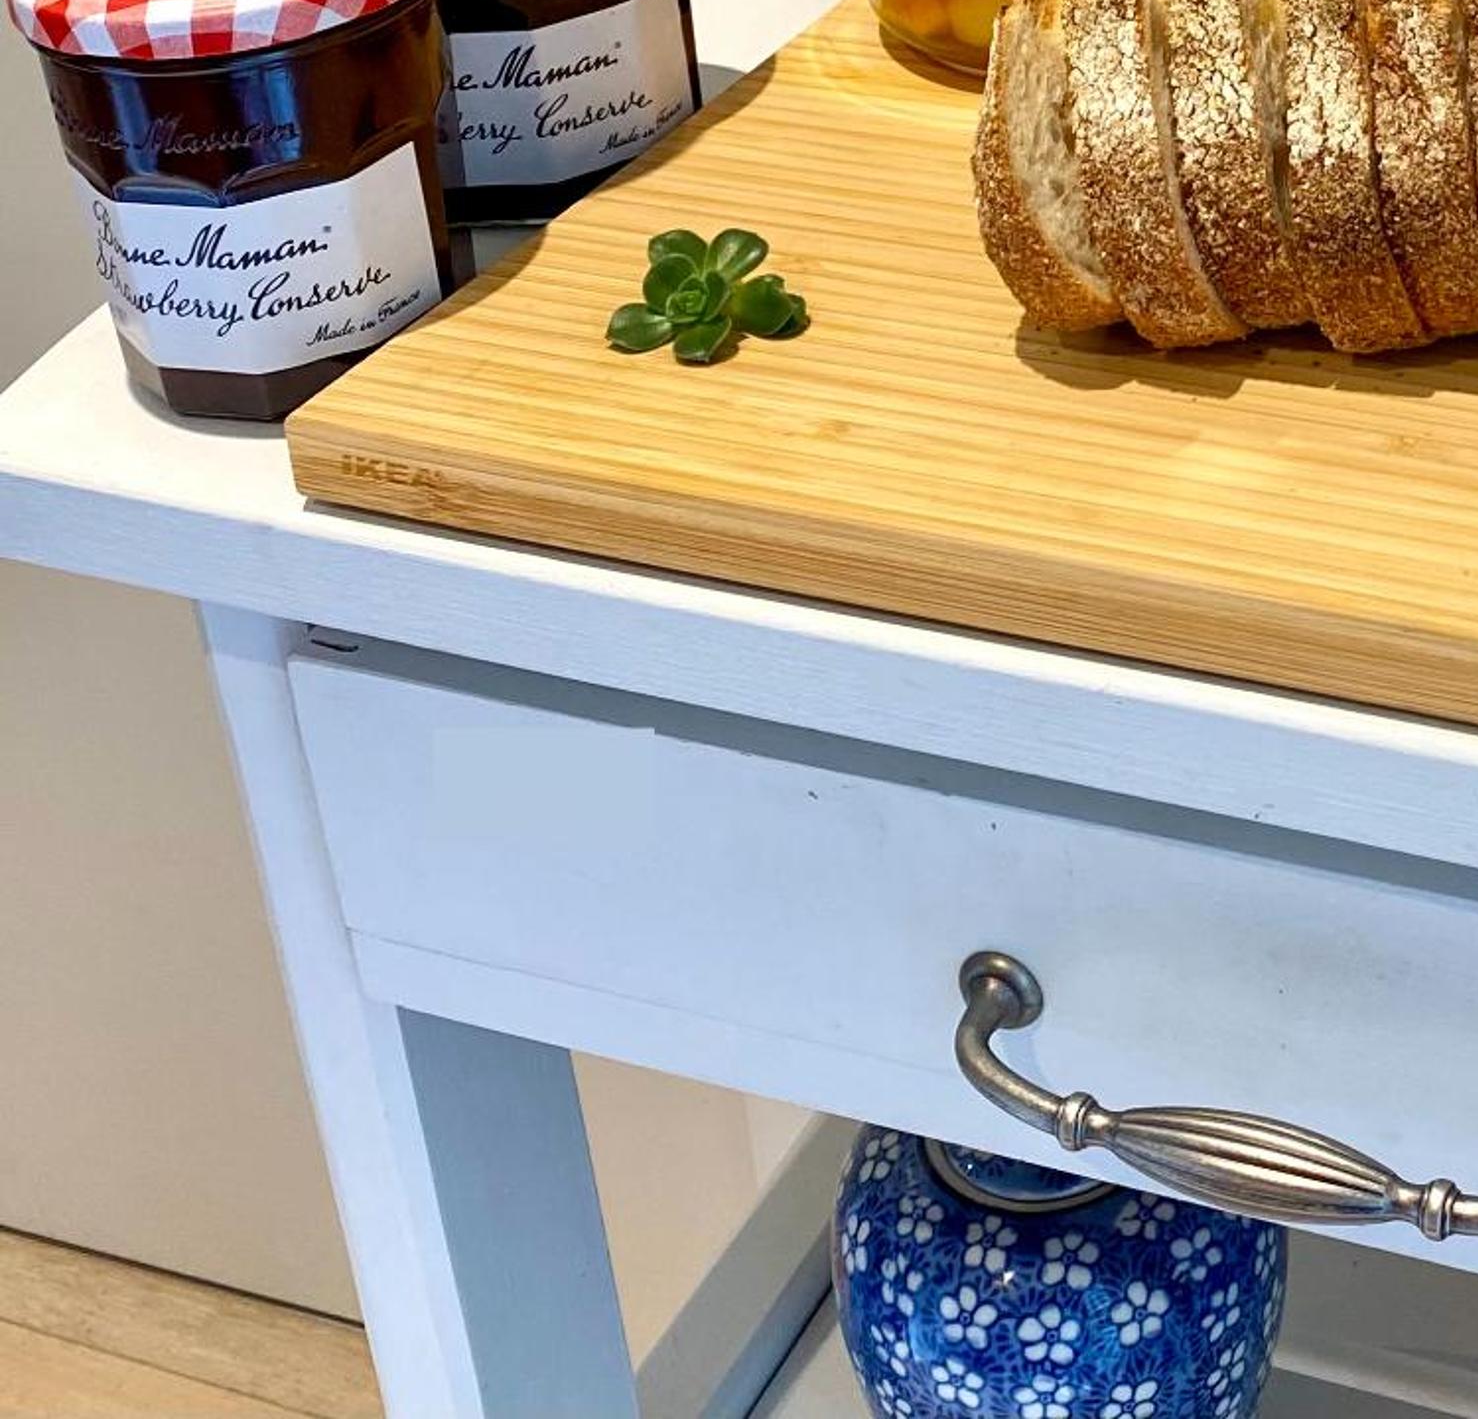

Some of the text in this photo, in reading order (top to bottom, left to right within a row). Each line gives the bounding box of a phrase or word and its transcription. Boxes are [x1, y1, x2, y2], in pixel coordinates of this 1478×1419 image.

[483, 44, 619, 90] Maman
[534, 91, 653, 139] Conserve
[92, 200, 329, 271] Bonne Maman
[96, 236, 391, 337] Strawberry Conserve
[306, 289, 422, 347] Made in France
